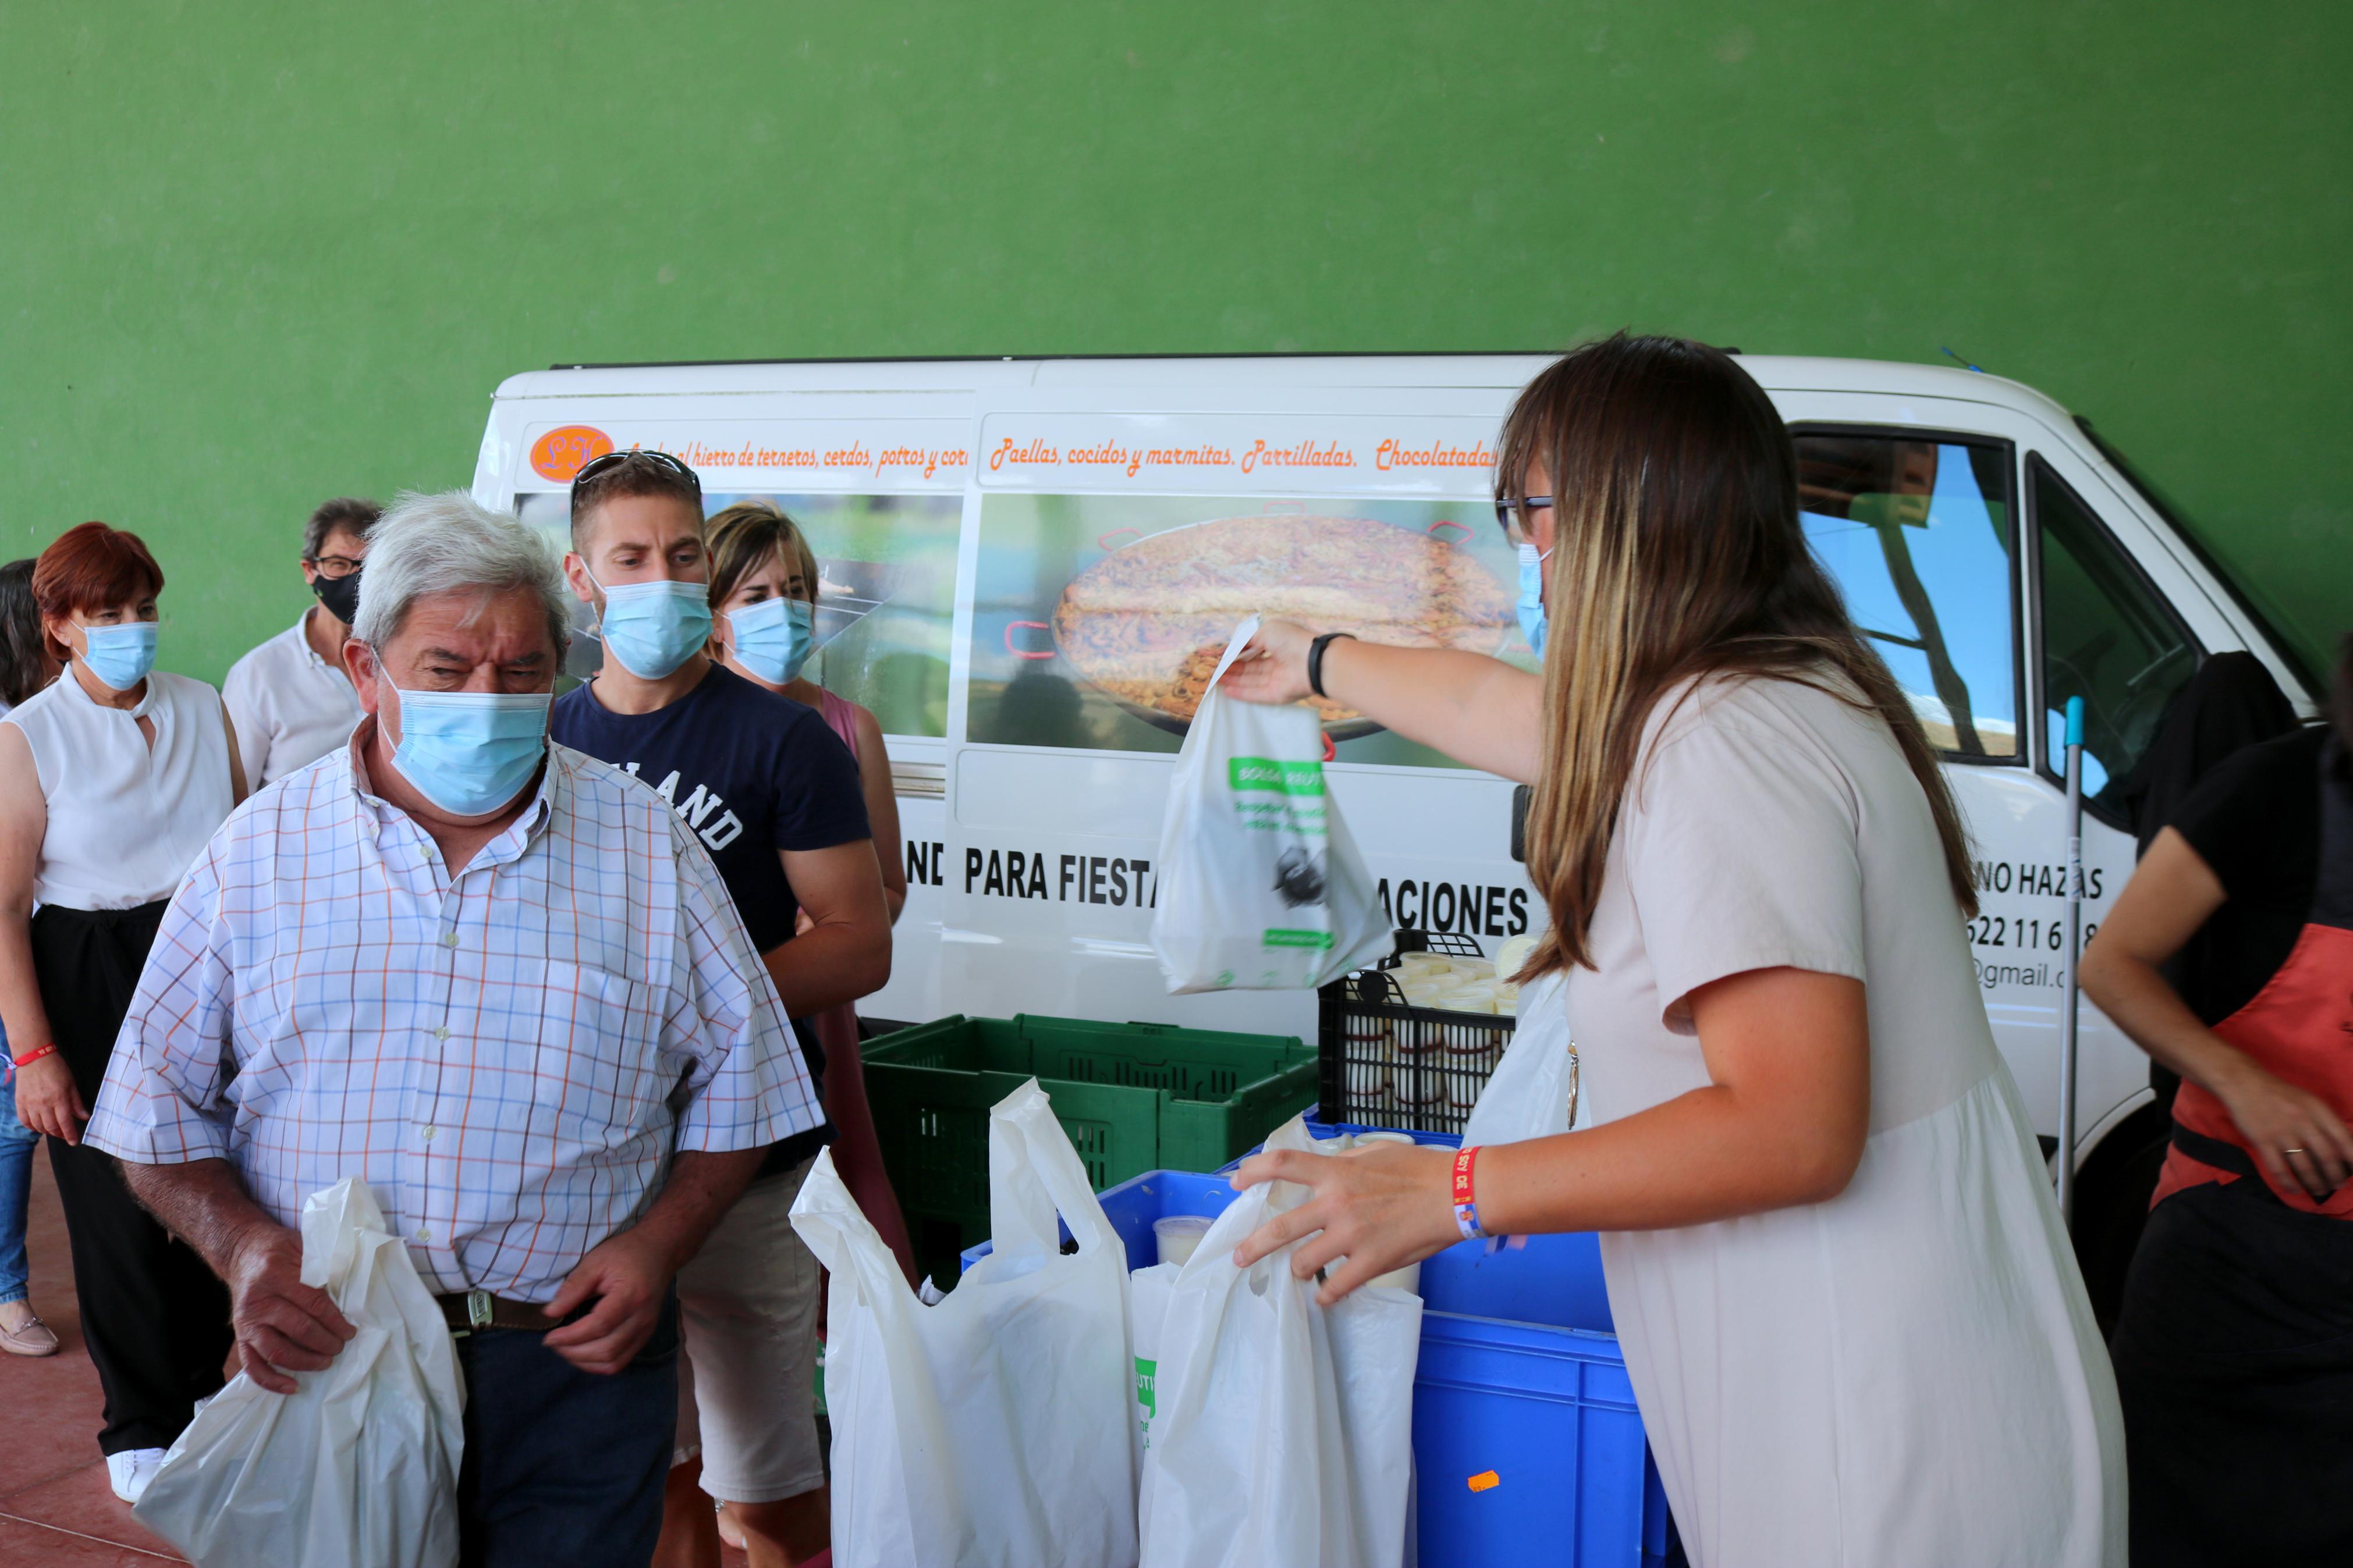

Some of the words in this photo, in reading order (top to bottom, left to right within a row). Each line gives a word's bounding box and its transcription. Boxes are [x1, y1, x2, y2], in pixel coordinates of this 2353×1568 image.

[692, 441, 735, 466] hierro
[738, 440, 754, 465] de
[757, 447, 819, 470] terneros,
[824, 439, 872, 469] cerdos,
[875, 445, 924, 478] potros
[923, 450, 938, 479] y
[991, 438, 1062, 471] Paellas,
[1068, 439, 1127, 464] cocidos
[1127, 450, 1141, 478] y
[1146, 445, 1234, 465] marmitas.
[1241, 439, 1357, 474] Parrilladas.
[966, 847, 1048, 900] PARA
[1059, 854, 1158, 908] FIEST
[2015, 918, 2039, 948] 11
[1456, 1175, 1468, 1190] DE
